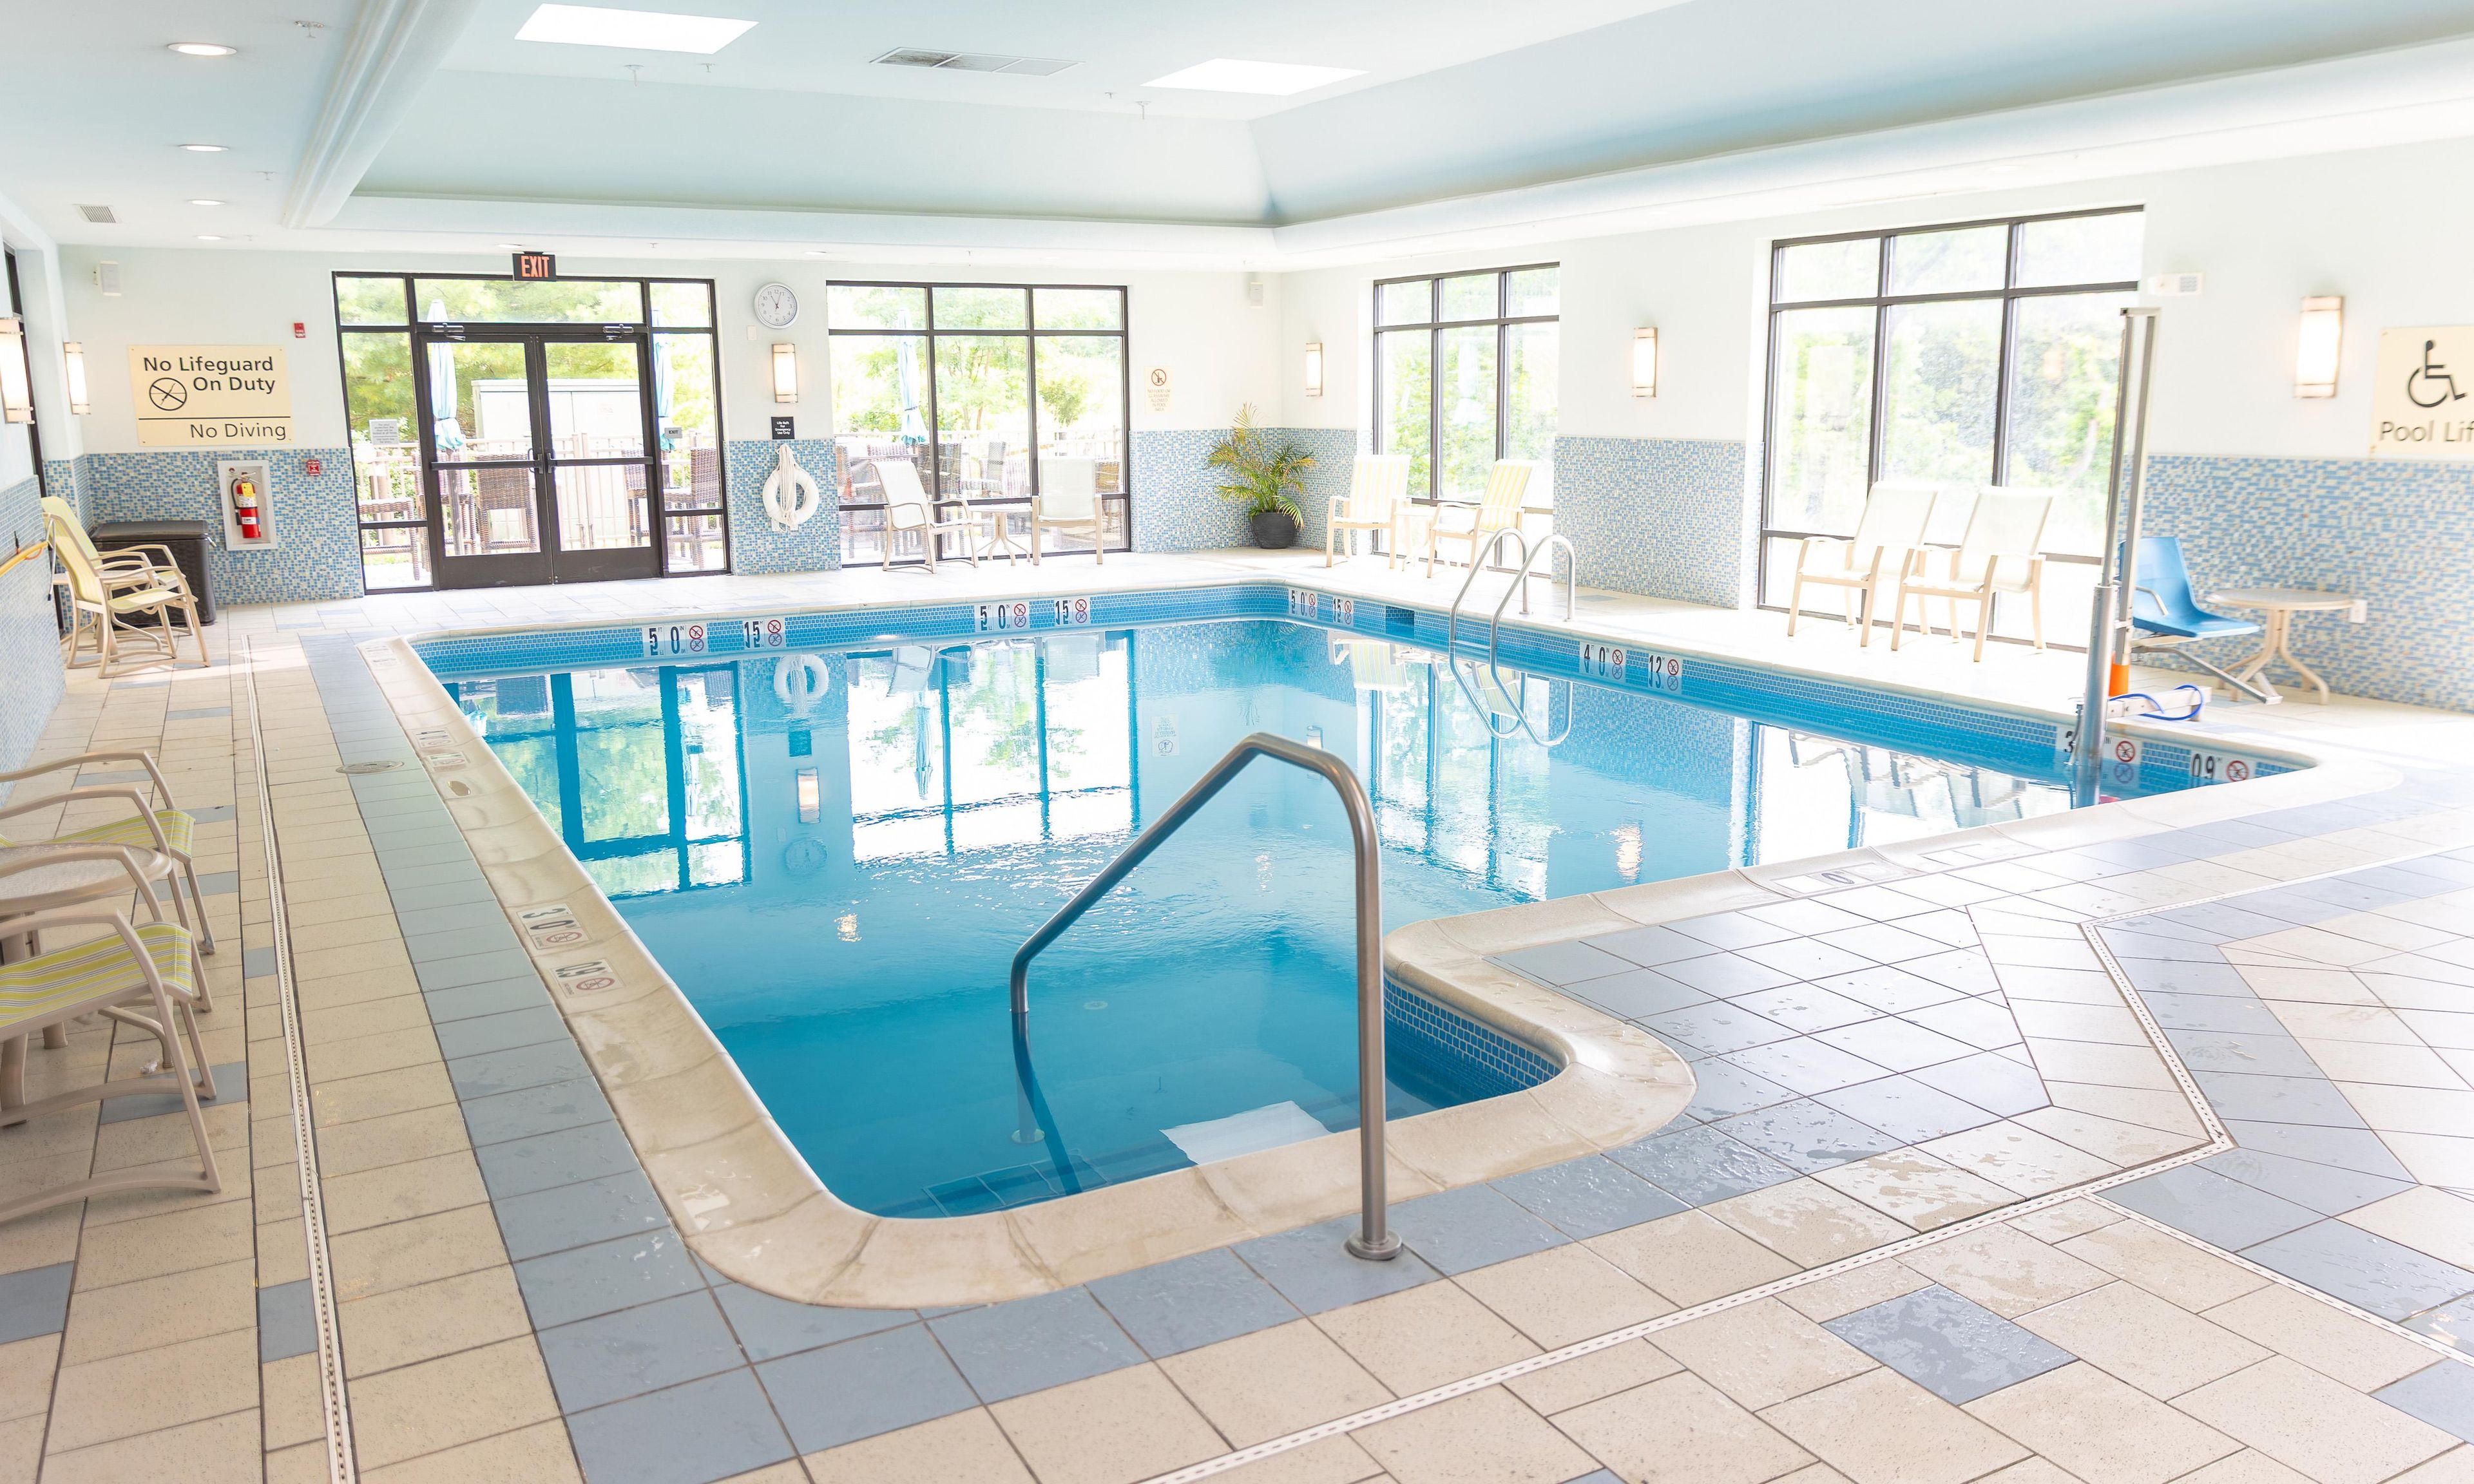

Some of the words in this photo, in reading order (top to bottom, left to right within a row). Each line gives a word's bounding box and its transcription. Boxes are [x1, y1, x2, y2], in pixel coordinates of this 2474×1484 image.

[521, 255, 550, 278] EXIT
[144, 357, 171, 372] No
[179, 356, 273, 375] Lifeguard
[193, 377, 221, 391] On
[229, 377, 276, 394] Duty
[191, 424, 217, 438] No
[225, 423, 287, 441] Diving
[2379, 420, 2434, 441] Pool
[1584, 644, 1590, 660] 4
[2064, 730, 2074, 753] 3
[522, 908, 566, 919] 3
[530, 920, 575, 930] 0
